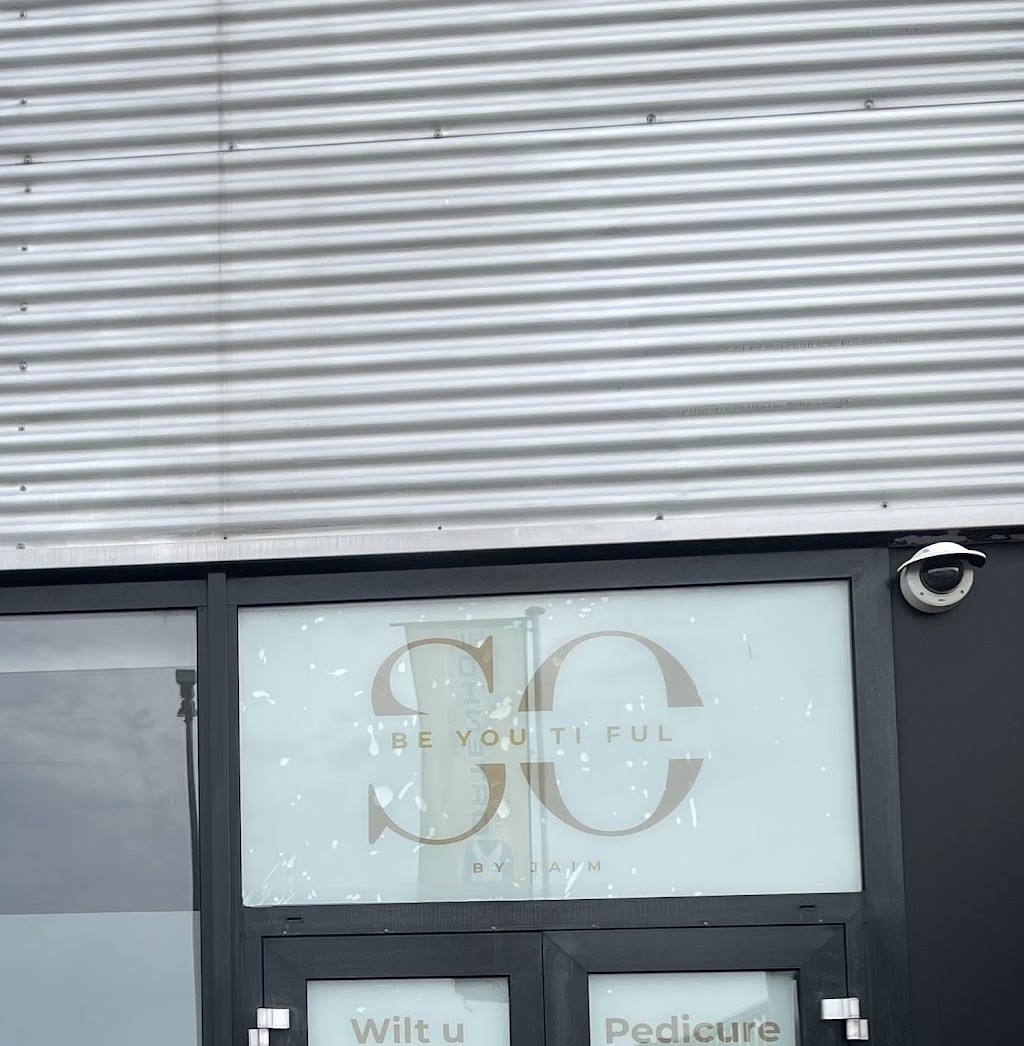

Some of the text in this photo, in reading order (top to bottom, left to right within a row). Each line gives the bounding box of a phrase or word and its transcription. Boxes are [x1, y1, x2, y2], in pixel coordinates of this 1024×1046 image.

[368, 630, 704, 846] SO
[391, 724, 673, 750] BE YOU TI FUL
[472, 859, 603, 875] BY JAIM
[350, 1015, 465, 1045] Wilt u
[605, 1014, 782, 1045] Pedicure
